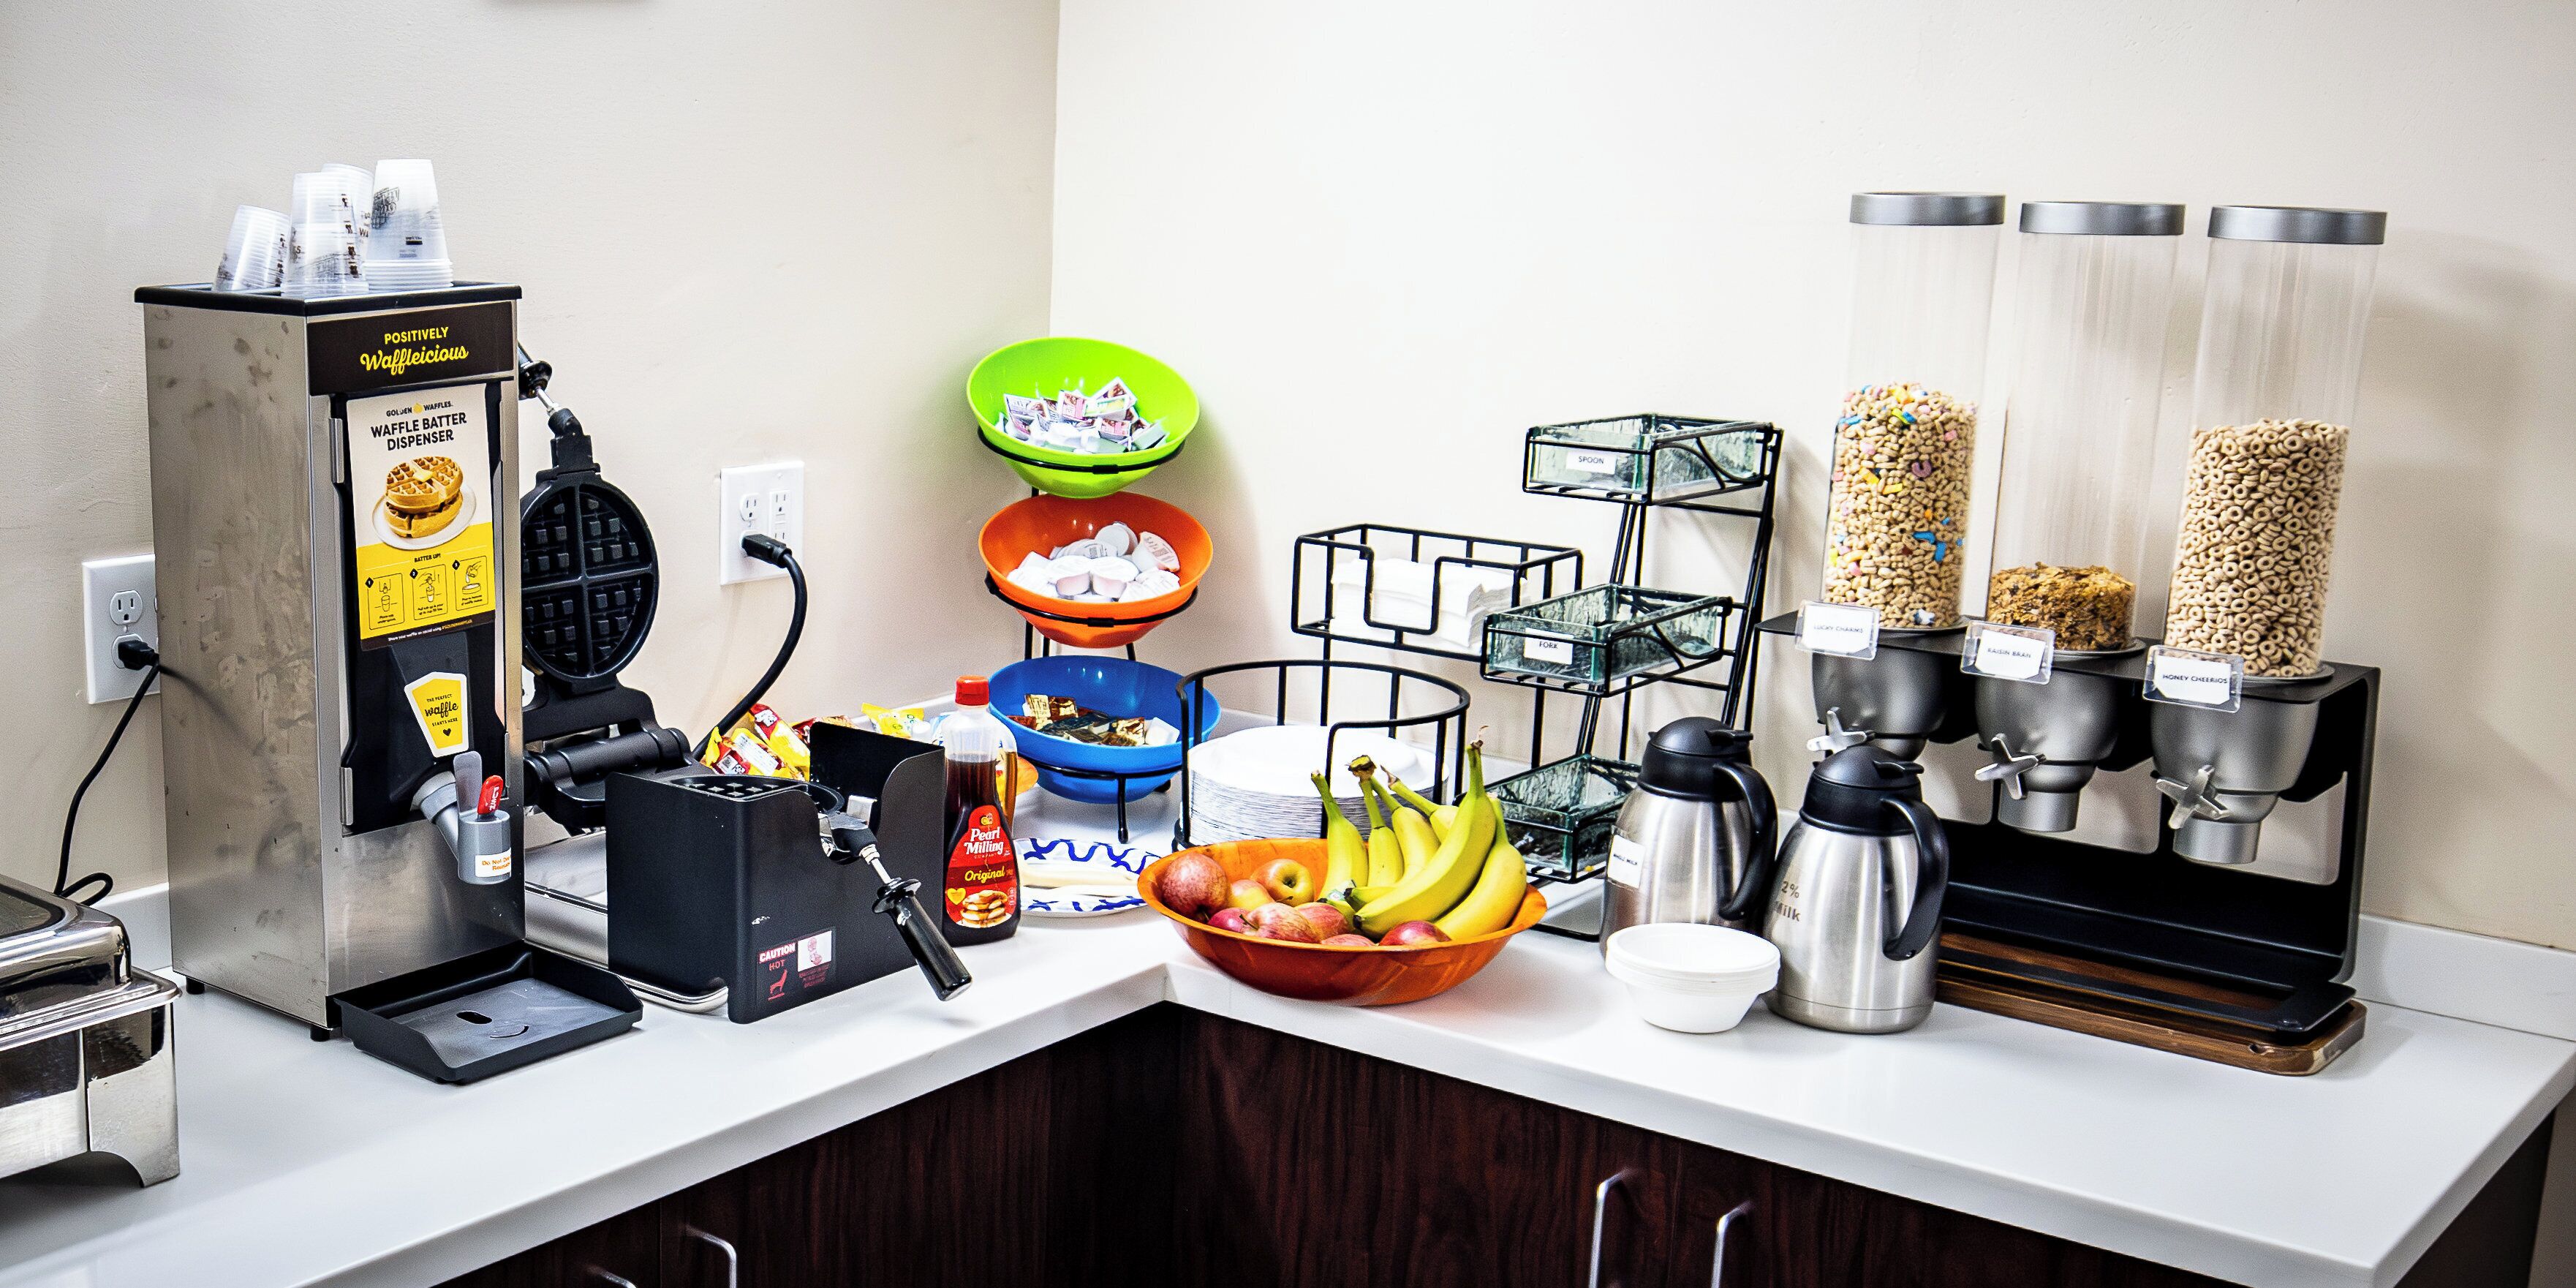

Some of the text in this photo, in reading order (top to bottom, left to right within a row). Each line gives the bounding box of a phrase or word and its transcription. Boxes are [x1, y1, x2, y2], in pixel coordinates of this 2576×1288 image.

[385, 327, 449, 344] POSITIVELY
[360, 344, 469, 375] Waffleicious
[386, 401, 451, 417] GOLDEN WAFFLES
[371, 412, 467, 438] WAFFLE BATTER
[387, 429, 454, 451] DISPENSER
[1579, 456, 1604, 464] SPOON
[1814, 623, 1833, 631] LUCKY
[1539, 641, 1558, 649] FORK
[1987, 647, 2010, 655] RAISIN
[2191, 676, 2228, 684] CHEERIOS
[424, 701, 458, 718] waffle
[970, 826, 1001, 842] Pearl
[964, 840, 1005, 855] Milling
[964, 865, 1005, 884] Original
[1781, 881, 1799, 898] 2%
[759, 942, 796, 963] CAUTION
[768, 960, 786, 971] HOT
